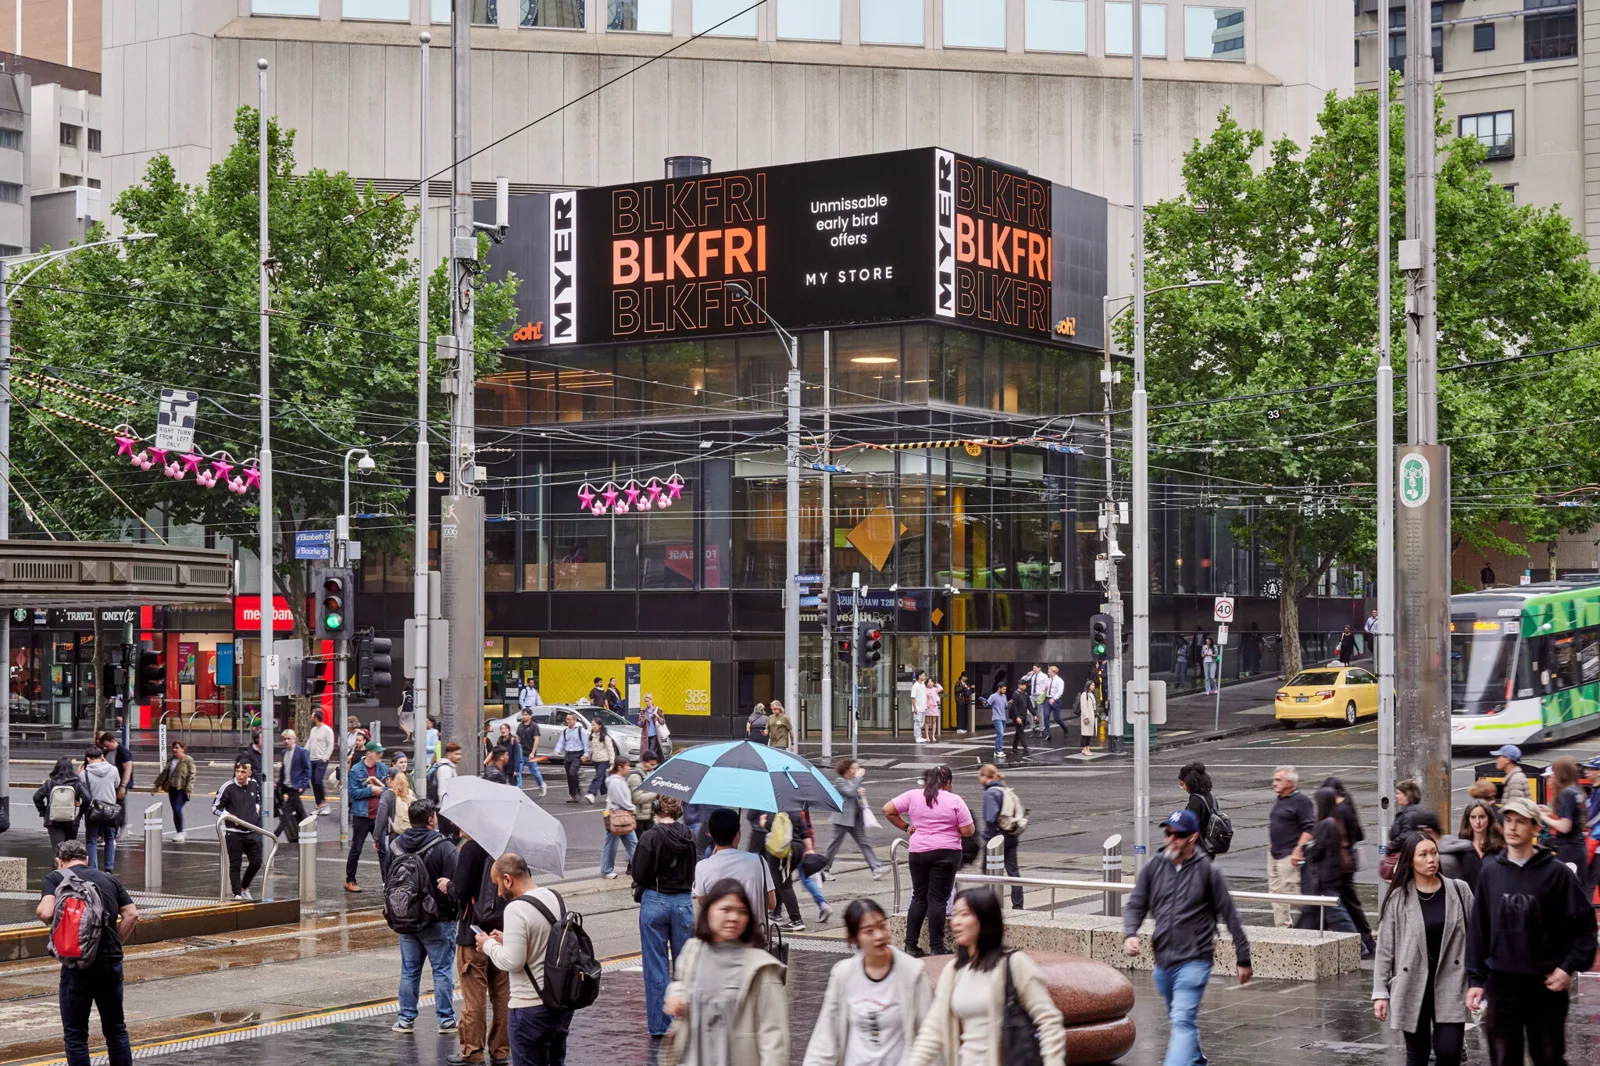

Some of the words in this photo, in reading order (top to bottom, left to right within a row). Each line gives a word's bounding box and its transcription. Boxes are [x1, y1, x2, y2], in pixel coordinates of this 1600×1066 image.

[612, 173, 767, 236] BLKFRI
[810, 194, 888, 214] Unmissable
[955, 159, 1052, 232] BLKFRI
[816, 216, 849, 232] early
[852, 212, 879, 227] bird
[830, 232, 868, 247] offers
[938, 155, 952, 311] MYER
[612, 225, 767, 285] BLKFRI
[956, 213, 1052, 281] BLKFRI
[554, 197, 572, 338] MYER
[805, 272, 828, 286] MY
[838, 266, 893, 283] STORE
[612, 277, 767, 336] BLKFRI
[956, 266, 1052, 333] BLKFRI
[1267, 409, 1280, 419] 33
[159, 426, 175, 434] RIGHT
[177, 428, 191, 436] TURN
[159, 433, 173, 441] FROM
[301, 547, 320, 555] Bourke
[66, 611, 95, 621] TRAVEL
[1217, 605, 1231, 615] 40
[684, 689, 708, 704] 385
[686, 704, 708, 712] Bourke
